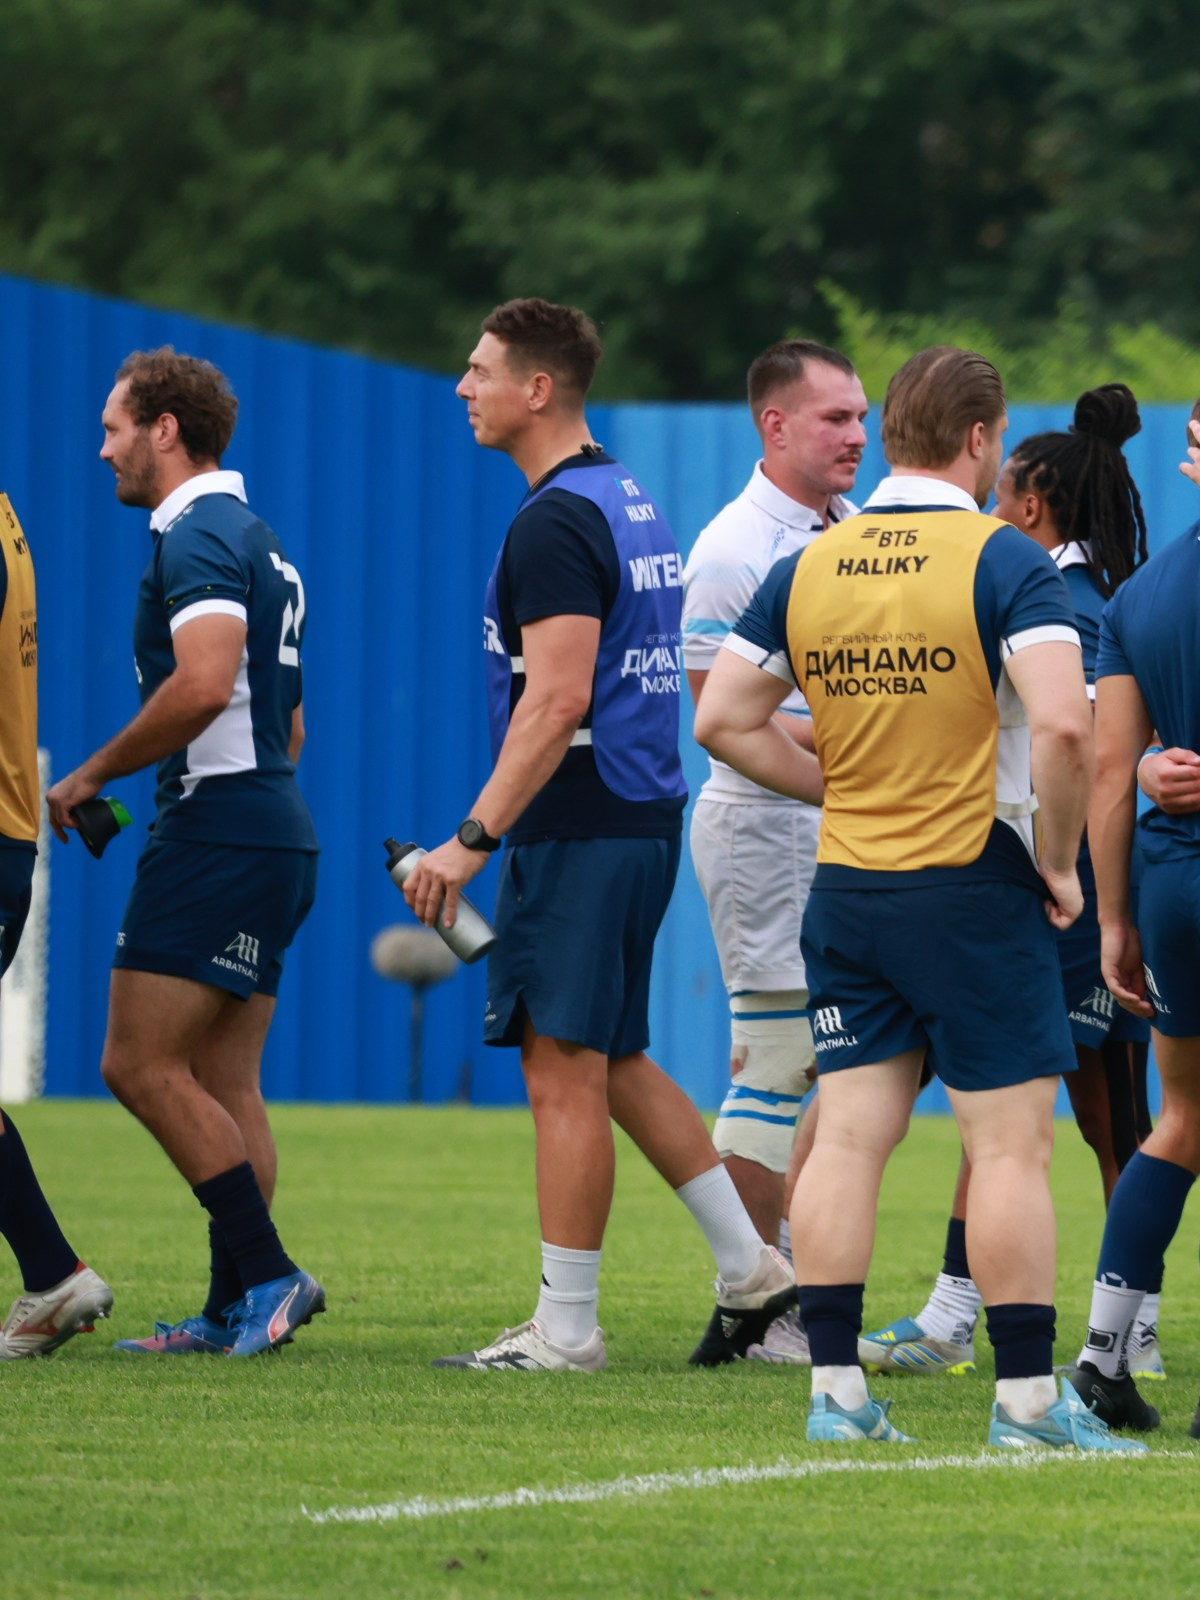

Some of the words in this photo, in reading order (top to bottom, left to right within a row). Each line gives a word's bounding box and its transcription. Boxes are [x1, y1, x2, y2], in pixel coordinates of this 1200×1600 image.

[878, 529, 919, 547] ВТБ
[836, 555, 929, 576] HALIKY
[895, 632, 927, 643] КЛУБ
[805, 646, 957, 680] ДИНАМО
[825, 676, 928, 697] МОСКВА
